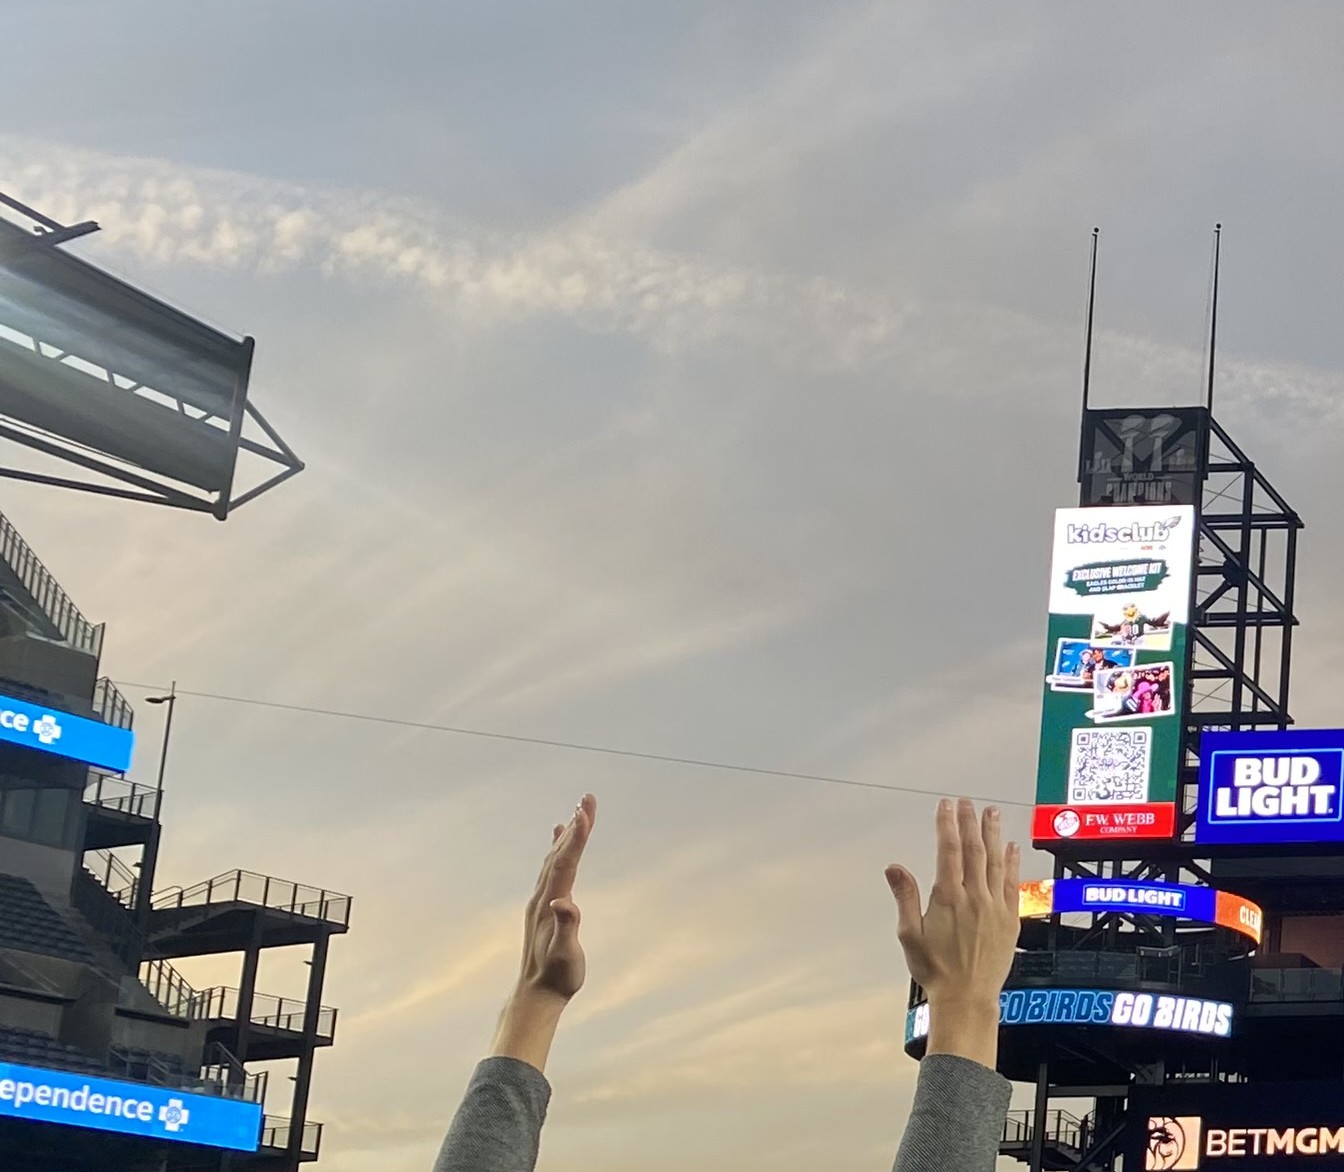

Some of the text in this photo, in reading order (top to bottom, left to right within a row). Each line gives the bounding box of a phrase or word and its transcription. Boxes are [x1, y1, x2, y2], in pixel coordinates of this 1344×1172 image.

[1067, 521, 1170, 544] kidsclub
[1233, 756, 1321, 787] BUD
[1215, 785, 1336, 817] LIGHT
[1100, 826, 1138, 834] COMPANY
[1113, 812, 1156, 825] WEBB
[1085, 887, 1183, 907] BUD LIGHT
[1025, 990, 1115, 1023] BIRDS
[1112, 992, 1232, 1036] GO BIRDS
